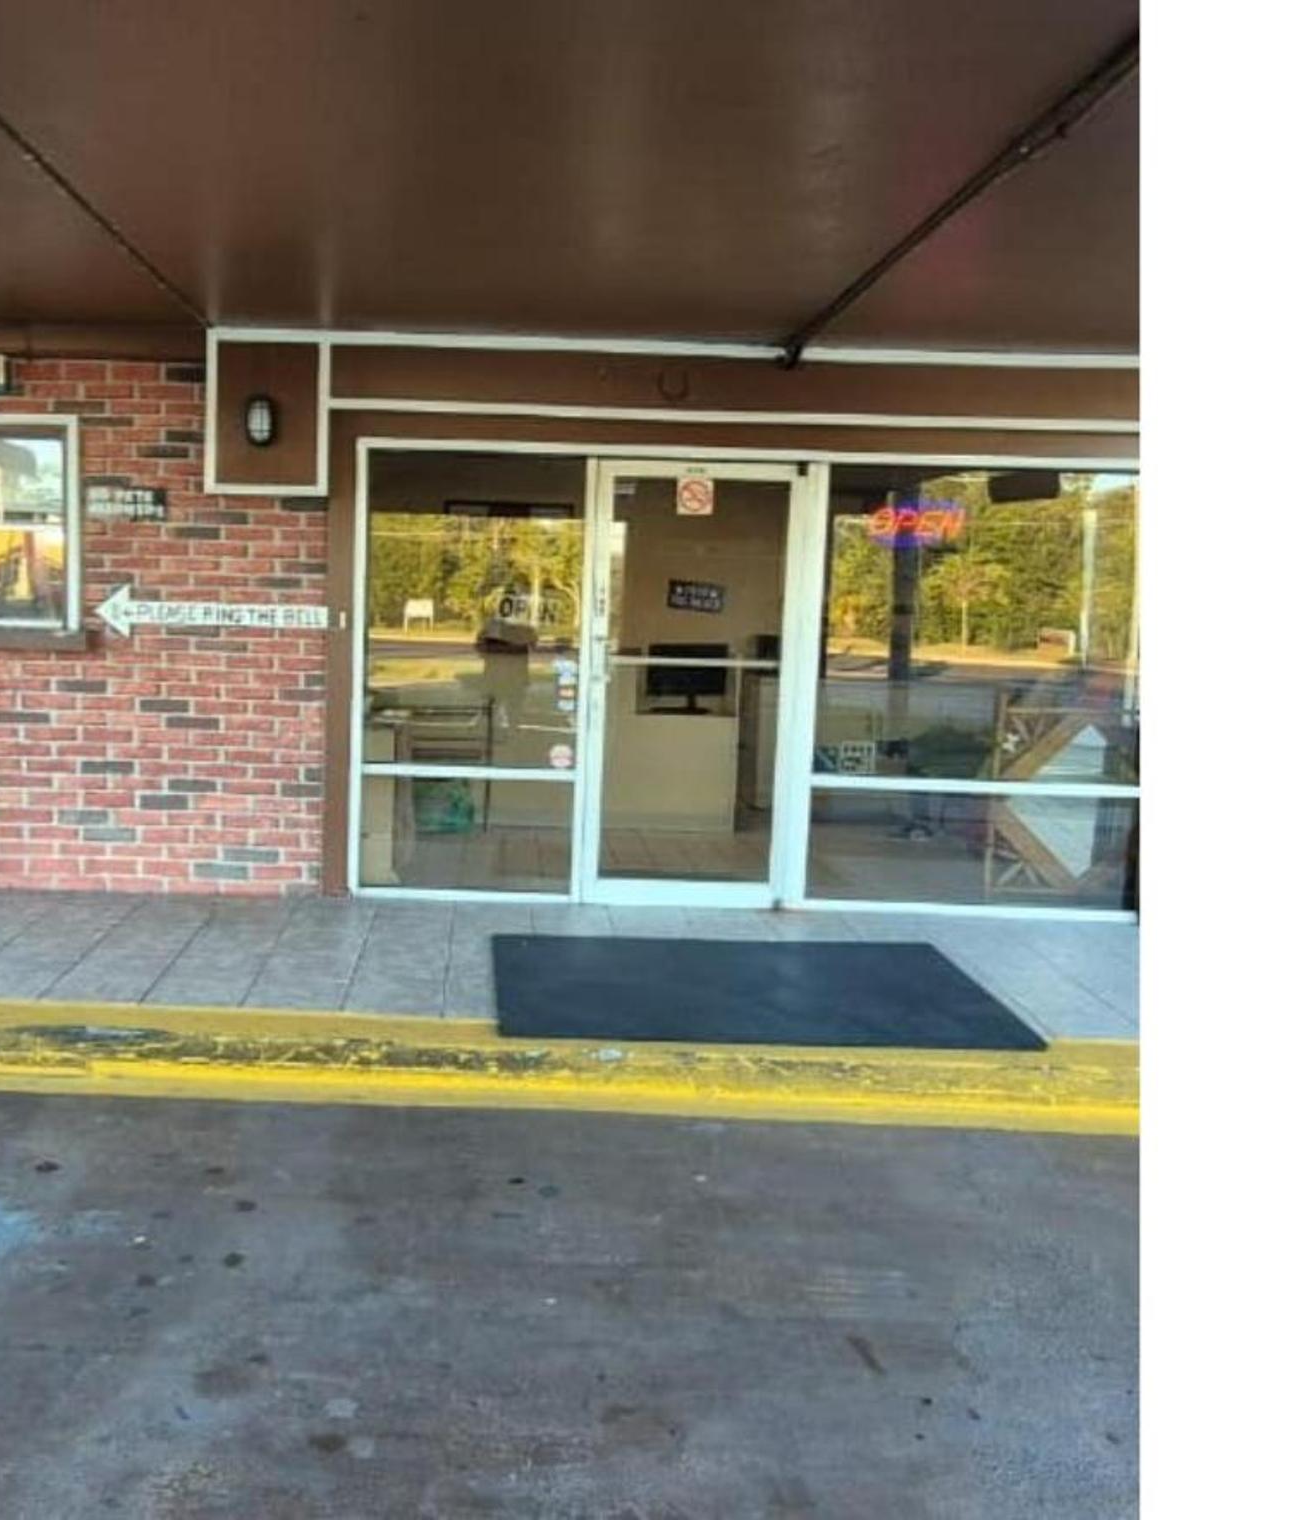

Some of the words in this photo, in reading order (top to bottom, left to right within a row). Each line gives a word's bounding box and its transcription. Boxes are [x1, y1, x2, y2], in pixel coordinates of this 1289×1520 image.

[868, 506, 966, 542] OPEN
[136, 603, 198, 621] PLEASE
[203, 605, 243, 624] RING
[246, 607, 276, 625] THE
[282, 608, 321, 626] BELL
[498, 596, 556, 623] OPN
